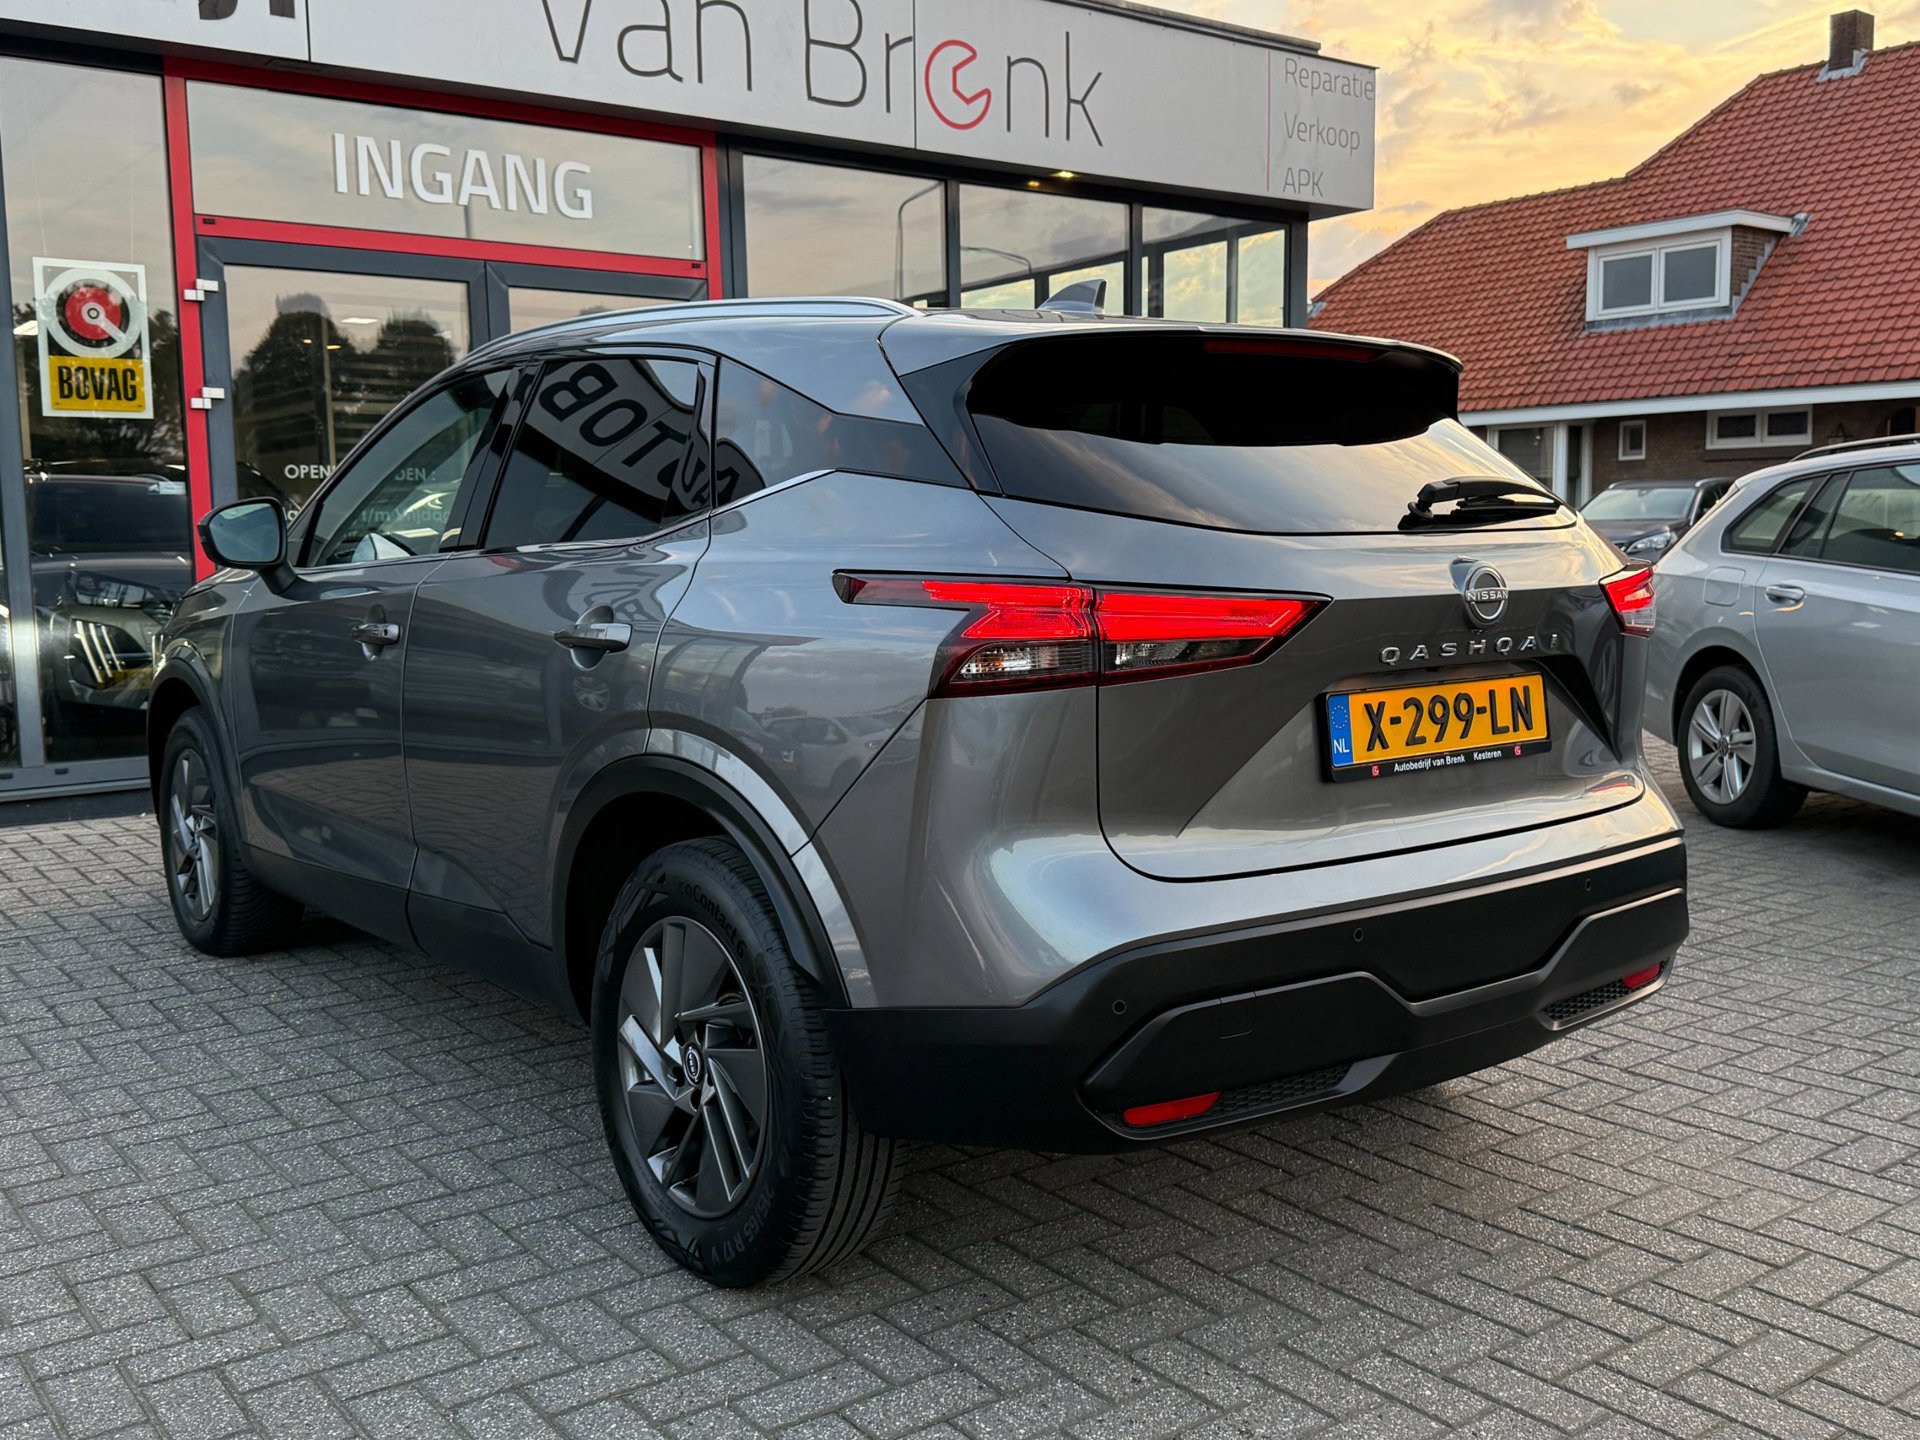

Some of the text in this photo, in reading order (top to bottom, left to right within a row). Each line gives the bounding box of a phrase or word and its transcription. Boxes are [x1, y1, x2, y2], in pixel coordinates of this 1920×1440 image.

[803, 0, 1104, 148] Brenk
[1284, 57, 1375, 101] Reparatie
[1284, 112, 1361, 157] Verkoop
[333, 132, 594, 219] INGANG
[1282, 166, 1324, 198] APK
[57, 365, 138, 402] BOVAG
[284, 464, 336, 480] OPEN
[1467, 590, 1508, 601] NISSAN
[1379, 633, 1559, 666] QASHQAI
[1363, 685, 1534, 752] X-299-LN
[1333, 739, 1350, 754] NL
[1393, 750, 1502, 773] Autobedrijf van Brenk Kesteren
